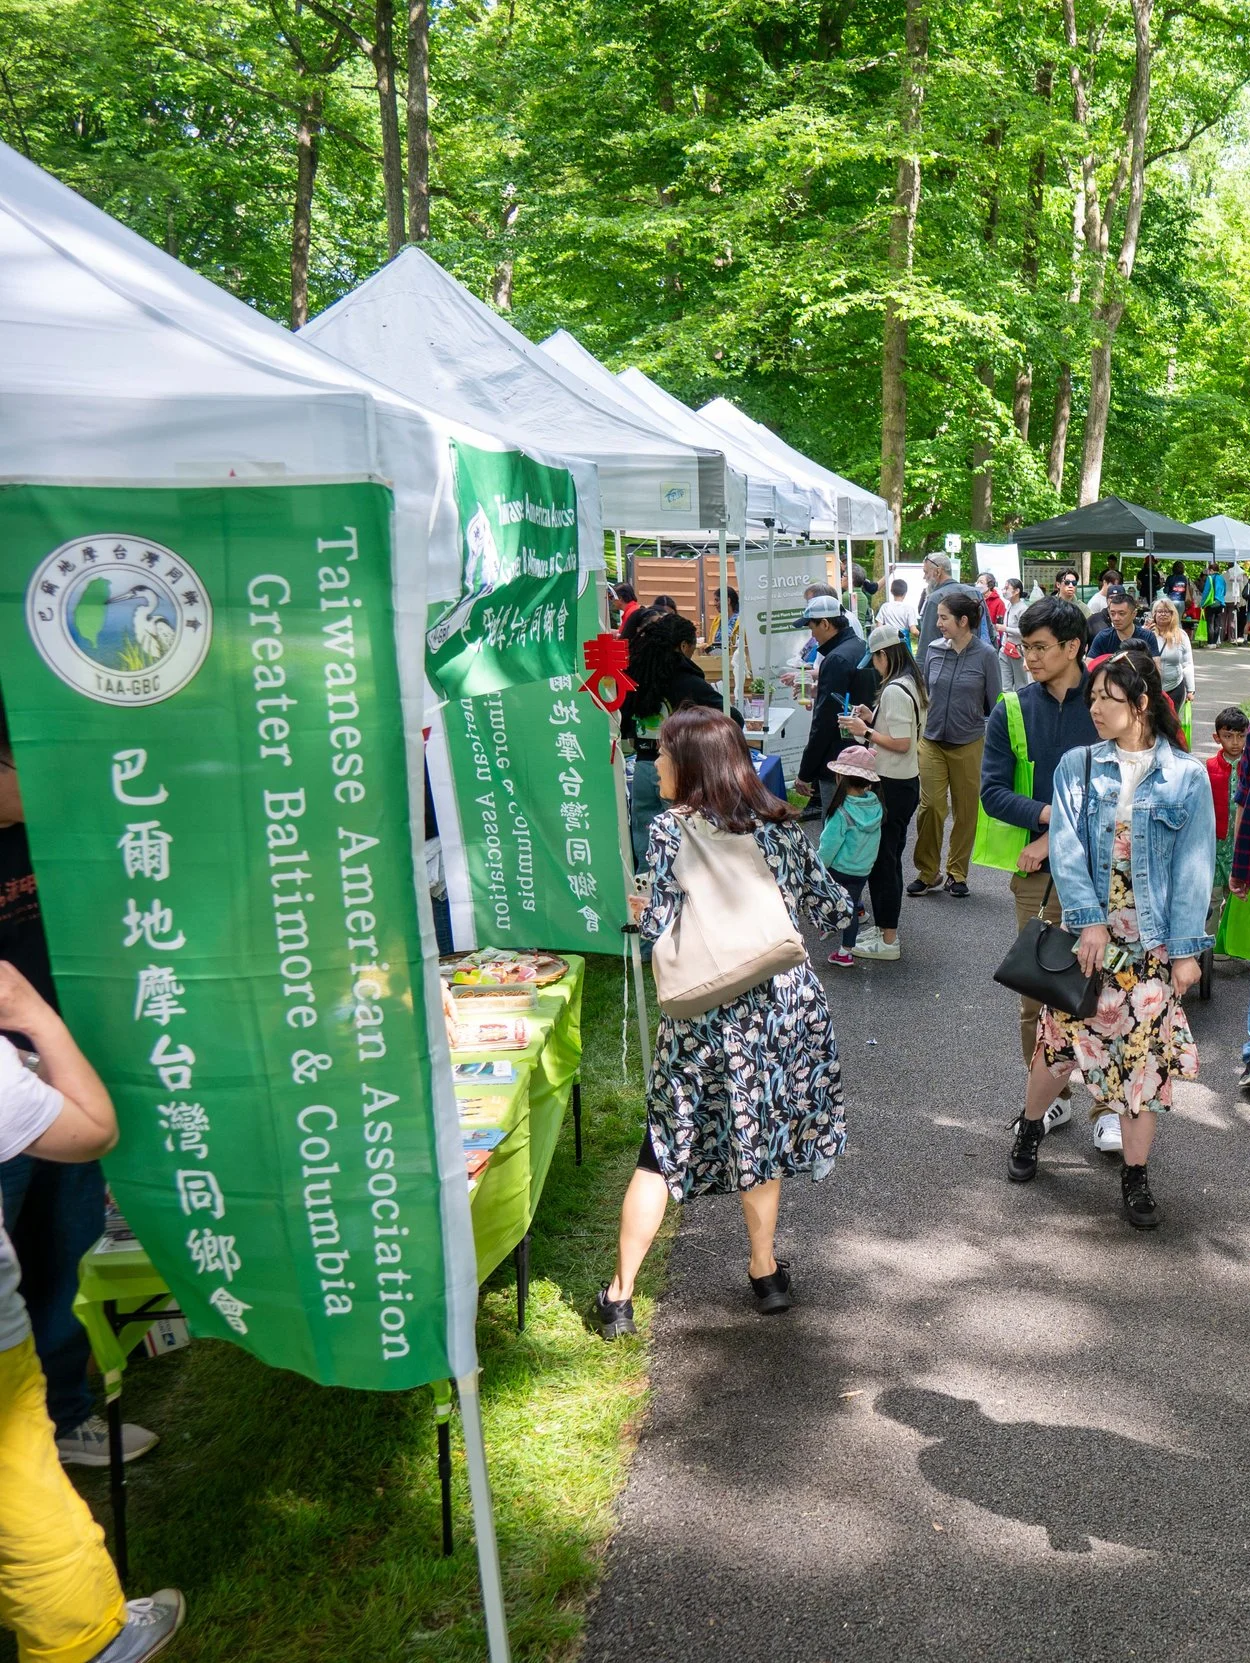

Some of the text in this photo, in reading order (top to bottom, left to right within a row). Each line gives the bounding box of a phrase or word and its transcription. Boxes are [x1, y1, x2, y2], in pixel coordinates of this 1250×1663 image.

[95, 673, 161, 696] TAA-GBC
[247, 573, 356, 1318] Greater Baltimore & Columbia
[316, 525, 413, 1361] Taiwanese American Association
[111, 747, 254, 1336] 巴爾地摩台灣同鄉會
